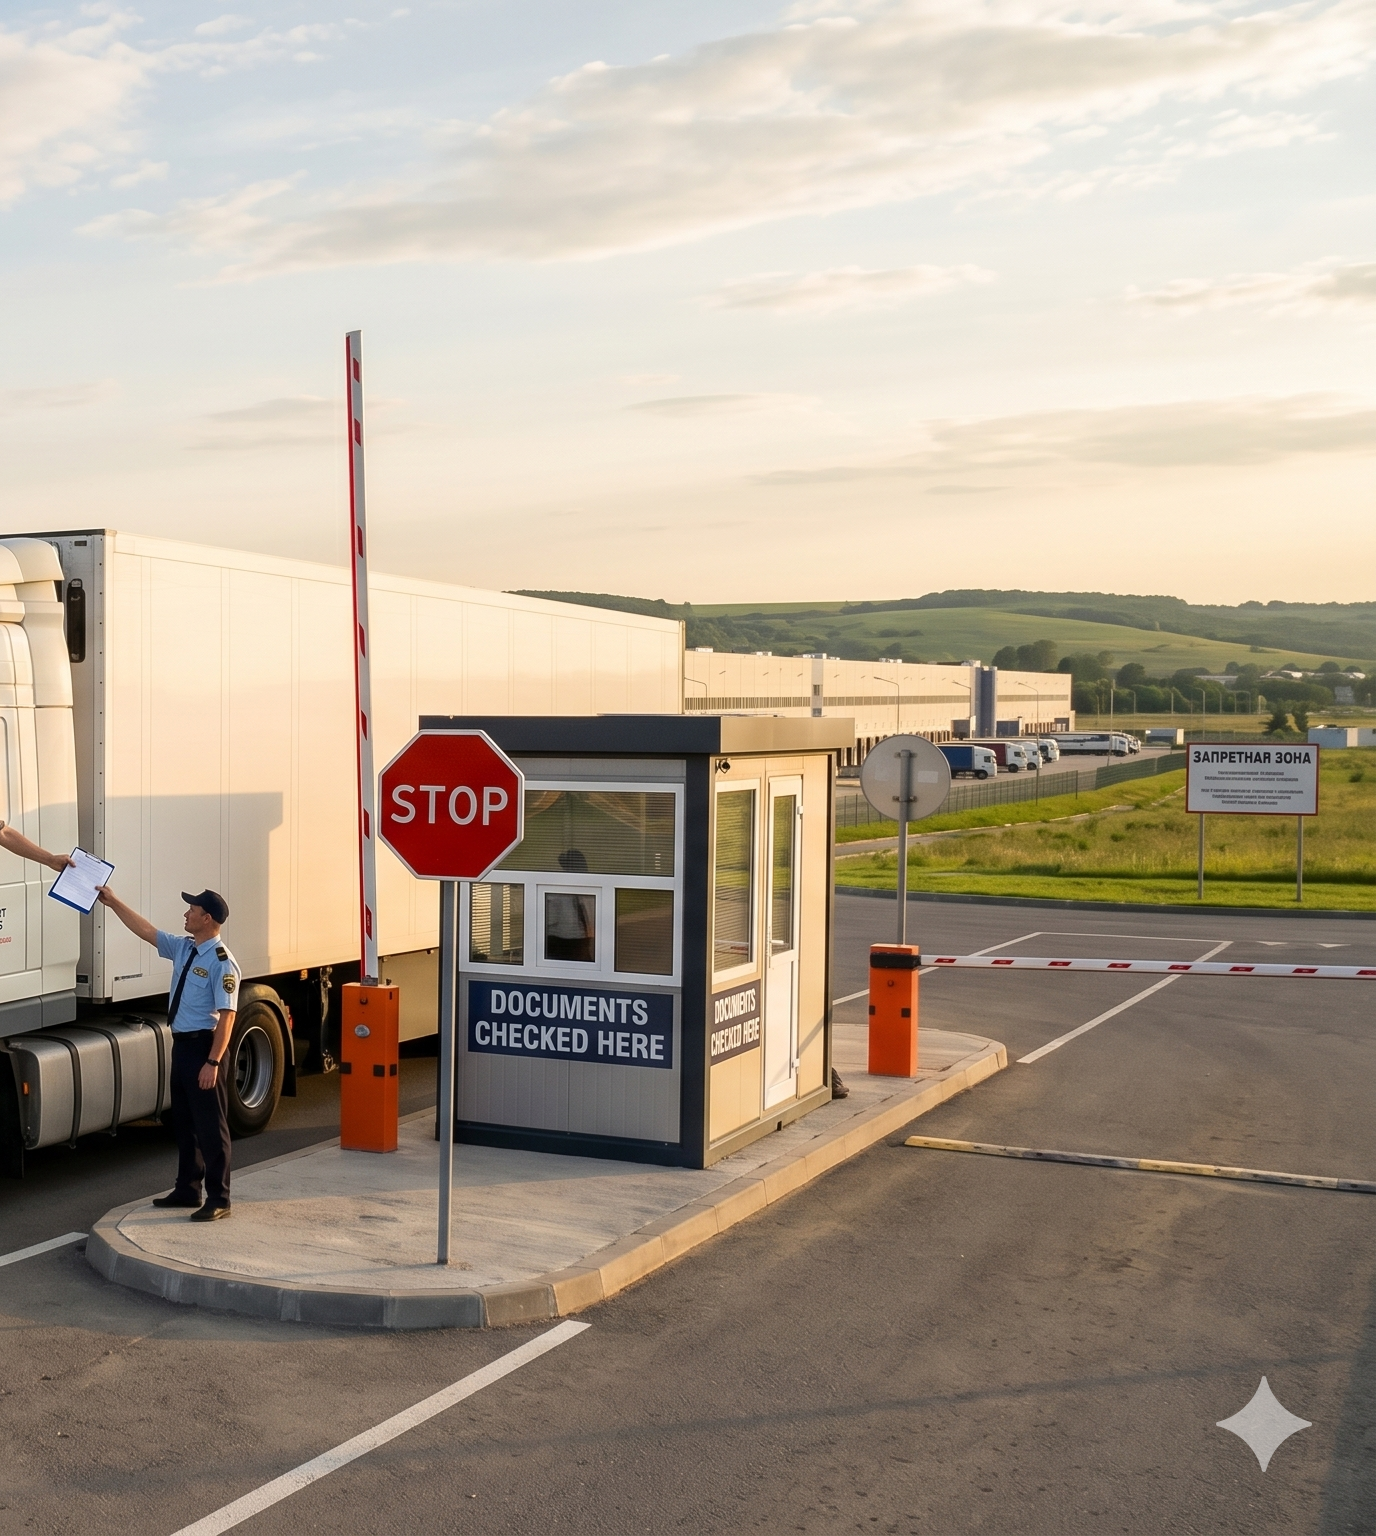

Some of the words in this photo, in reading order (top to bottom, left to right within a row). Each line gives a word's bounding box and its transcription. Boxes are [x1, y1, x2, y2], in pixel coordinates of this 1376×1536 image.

[1193, 751, 1271, 764] ЗАПРЕТНАЯ
[1275, 752, 1311, 764] ЗОНА
[391, 784, 509, 826] STOP
[491, 989, 648, 1026] DOCUMENTS
[475, 1021, 588, 1053] CHECKED
[597, 1030, 665, 1061] HERE
